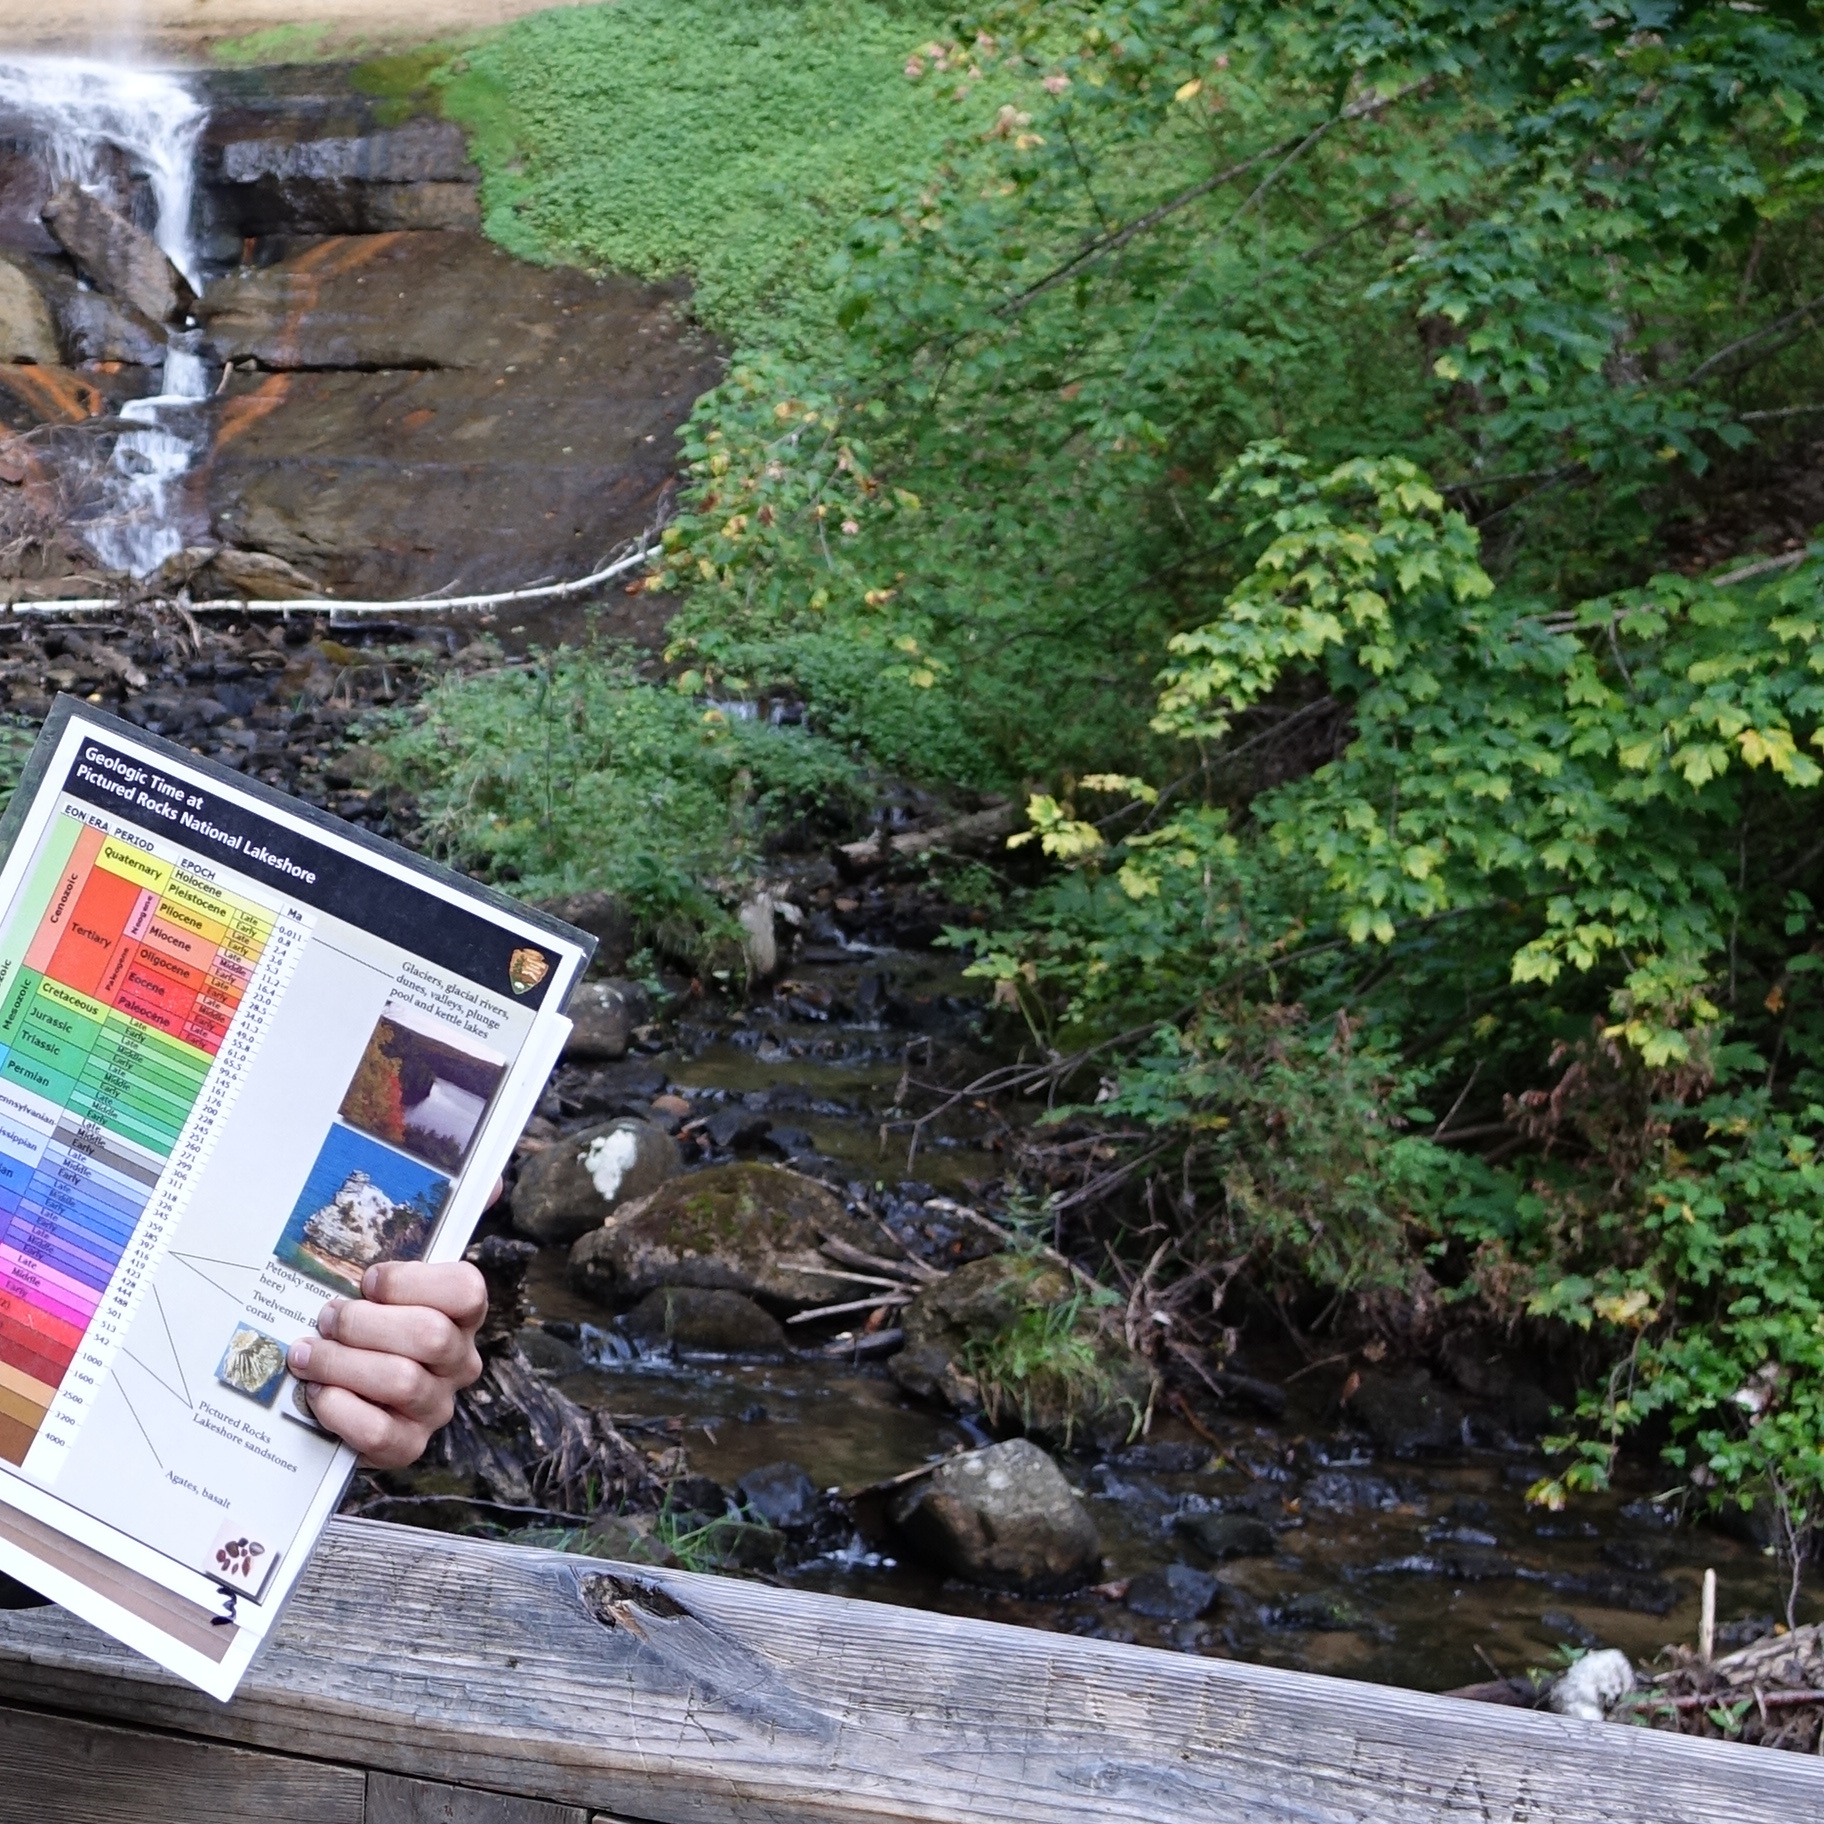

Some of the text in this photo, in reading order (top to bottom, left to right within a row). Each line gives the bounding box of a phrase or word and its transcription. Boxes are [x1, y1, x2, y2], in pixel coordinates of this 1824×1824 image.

[81, 744, 205, 811] Geologic Time at
[63, 804, 87, 821] EON
[74, 762, 319, 885] Pictured Rocks National Lakeshore
[87, 815, 110, 831] ERA
[113, 827, 155, 852] PERIOD
[101, 845, 163, 882] Quaternary
[179, 857, 216, 881] EPOCH
[173, 868, 224, 898] Holocene
[48, 871, 79, 925] Cenozoic
[166, 882, 228, 917] Pleistocene
[130, 894, 155, 936] Neogene
[158, 902, 204, 930] Pliocene
[239, 912, 259, 926] Late
[286, 907, 304, 922] Ma
[68, 921, 113, 950] Tertiary
[231, 930, 251, 945] Late
[234, 921, 258, 939] Early
[277, 925, 303, 942] 0.011
[148, 925, 193, 952] Miocene
[276, 936, 292, 948] 0.8
[222, 949, 243, 963] Late
[226, 940, 249, 957] Early
[272, 946, 287, 957] 2.4
[137, 947, 192, 981] Oligocene
[218, 958, 248, 977] Middle
[268, 954, 283, 967] 3.6
[104, 946, 131, 992] Paleogene
[213, 967, 237, 985] Early
[264, 963, 279, 975] 5.3
[127, 971, 166, 996] Eocene
[210, 977, 230, 992] Late
[260, 973, 280, 988] 11.2
[205, 986, 229, 1003] Early
[256, 983, 276, 997] 16.4
[399, 959, 512, 1020] Glaciers, glacial rivers,
[1, 977, 32, 1031] Mesozoic
[40, 981, 100, 1016] Cretaceous
[201, 995, 222, 1010] Late
[252, 992, 272, 1006] 23.0
[394, 972, 502, 1032] dunes, valleys, plunge
[116, 995, 172, 1028] Paleocene
[247, 1001, 268, 1016] 28.5
[388, 985, 490, 1039] pool and kettle lakes
[29, 1005, 74, 1034] Jurassic
[128, 1017, 148, 1032] Late
[243, 1010, 263, 1025] 34.0
[188, 1024, 209, 1038] Late
[239, 1020, 259, 1034] 41.3
[19, 1028, 62, 1056] Triassic
[119, 1035, 140, 1050] Late
[123, 1027, 147, 1044] Early
[234, 1029, 255, 1044] 49.0
[230, 1038, 251, 1053] 55.8
[110, 1053, 134, 1071] Early
[226, 1047, 247, 1062] 61.0
[107, 1063, 127, 1078] Late
[222, 1057, 243, 1071] 65.5
[6, 1059, 51, 1087] Permian
[218, 1066, 238, 1081] 99.6
[103, 1072, 132, 1091] Middle
[213, 1075, 231, 1089] 145
[98, 1081, 121, 1099] Early
[209, 1085, 226, 1098] 161
[94, 1091, 114, 1106] Late
[204, 1094, 223, 1108] 176
[85, 1108, 109, 1126] Early
[90, 1100, 119, 1119] Middle
[200, 1103, 218, 1117] 200
[80, 1118, 102, 1134] Late
[196, 1112, 214, 1126] 228
[191, 1122, 210, 1136] 245
[76, 1127, 107, 1148] Middle
[187, 1131, 205, 1144] 251
[70, 1137, 96, 1157] Early
[183, 1140, 201, 1154] 260
[66, 1148, 88, 1164] Late
[179, 1149, 197, 1163] 271
[62, 1158, 93, 1178] Middle
[175, 1159, 192, 1172] 299
[56, 1167, 82, 1186] Early
[170, 1168, 188, 1181] 306
[166, 1177, 184, 1190] 311
[160, 1190, 178, 1203] 318
[156, 1199, 174, 1212] 326
[152, 1208, 169, 1222] 345
[146, 1219, 164, 1233] 359
[137, 1238, 155, 1252] 397
[16, 1254, 38, 1270] Late
[133, 1248, 150, 1261] 416
[128, 1257, 146, 1270] 419
[10, 1266, 42, 1288] Middle
[124, 1266, 141, 1280] 423
[263, 1259, 333, 1300] Petosky stone
[4, 1280, 29, 1298] Early
[119, 1276, 137, 1290] 428
[258, 1272, 287, 1294] here)
[115, 1285, 132, 1298] 444
[105, 1307, 122, 1320] 501
[244, 1301, 277, 1324] corals
[250, 1288, 308, 1324] Twelvemile
[99, 1319, 117, 1333] 513
[93, 1333, 110, 1346] 542
[81, 1352, 103, 1368] 1000
[72, 1369, 95, 1385] 1600
[61, 1389, 83, 1405] 2500
[53, 1410, 76, 1426] 3200
[197, 1399, 273, 1444] Pictured Rocks
[43, 1431, 66, 1447] 4000
[191, 1412, 299, 1473] Lakeshore sandstones
[163, 1468, 232, 1510] Agates, basalt
